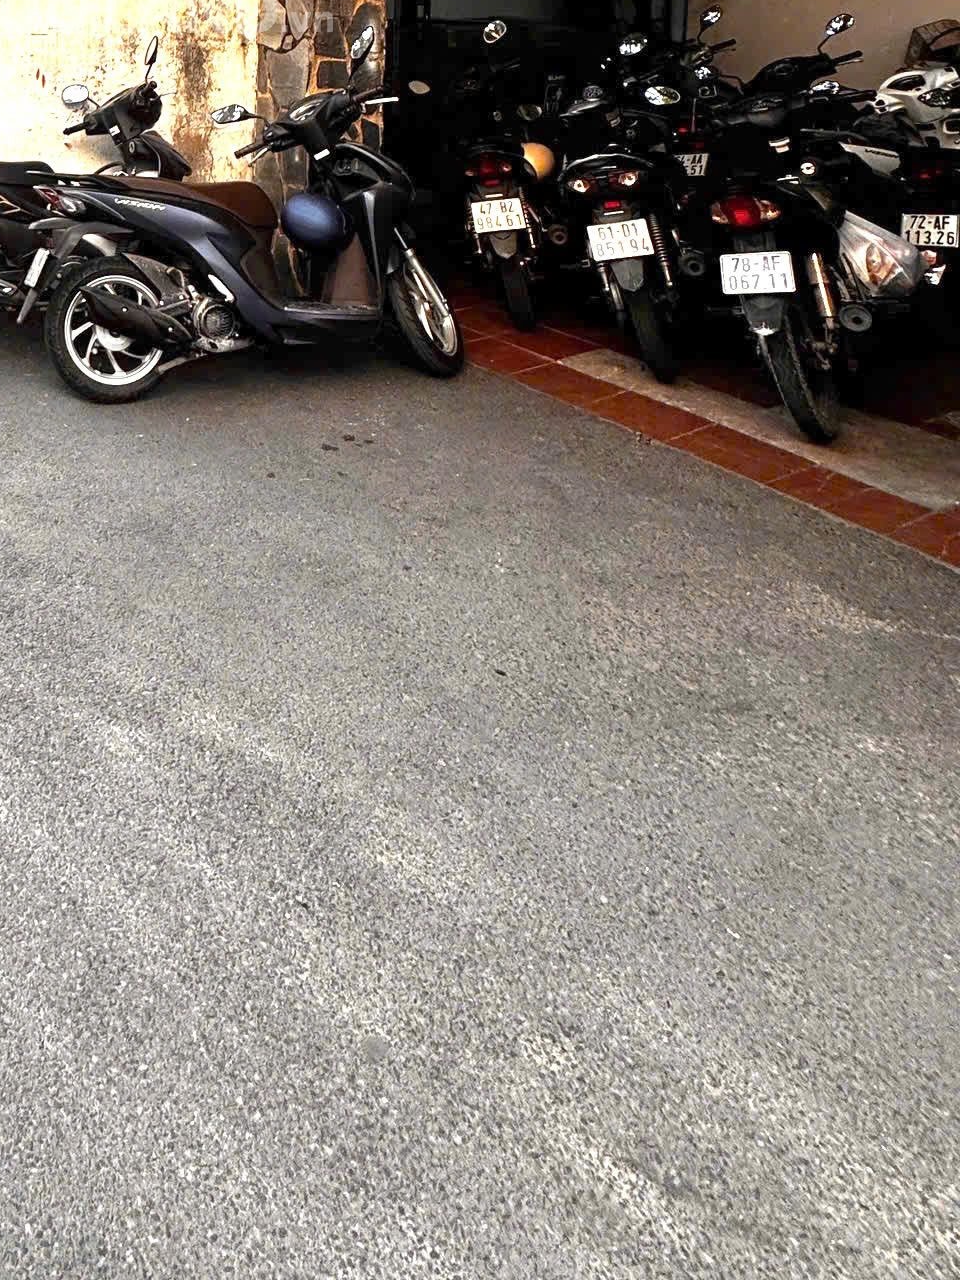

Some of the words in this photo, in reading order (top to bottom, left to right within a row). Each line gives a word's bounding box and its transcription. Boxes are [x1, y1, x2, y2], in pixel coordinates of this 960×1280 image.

[910, 215, 951, 230] 72-AF
[904, 229, 956, 245] 113.26
[731, 255, 781, 273] 78-AF
